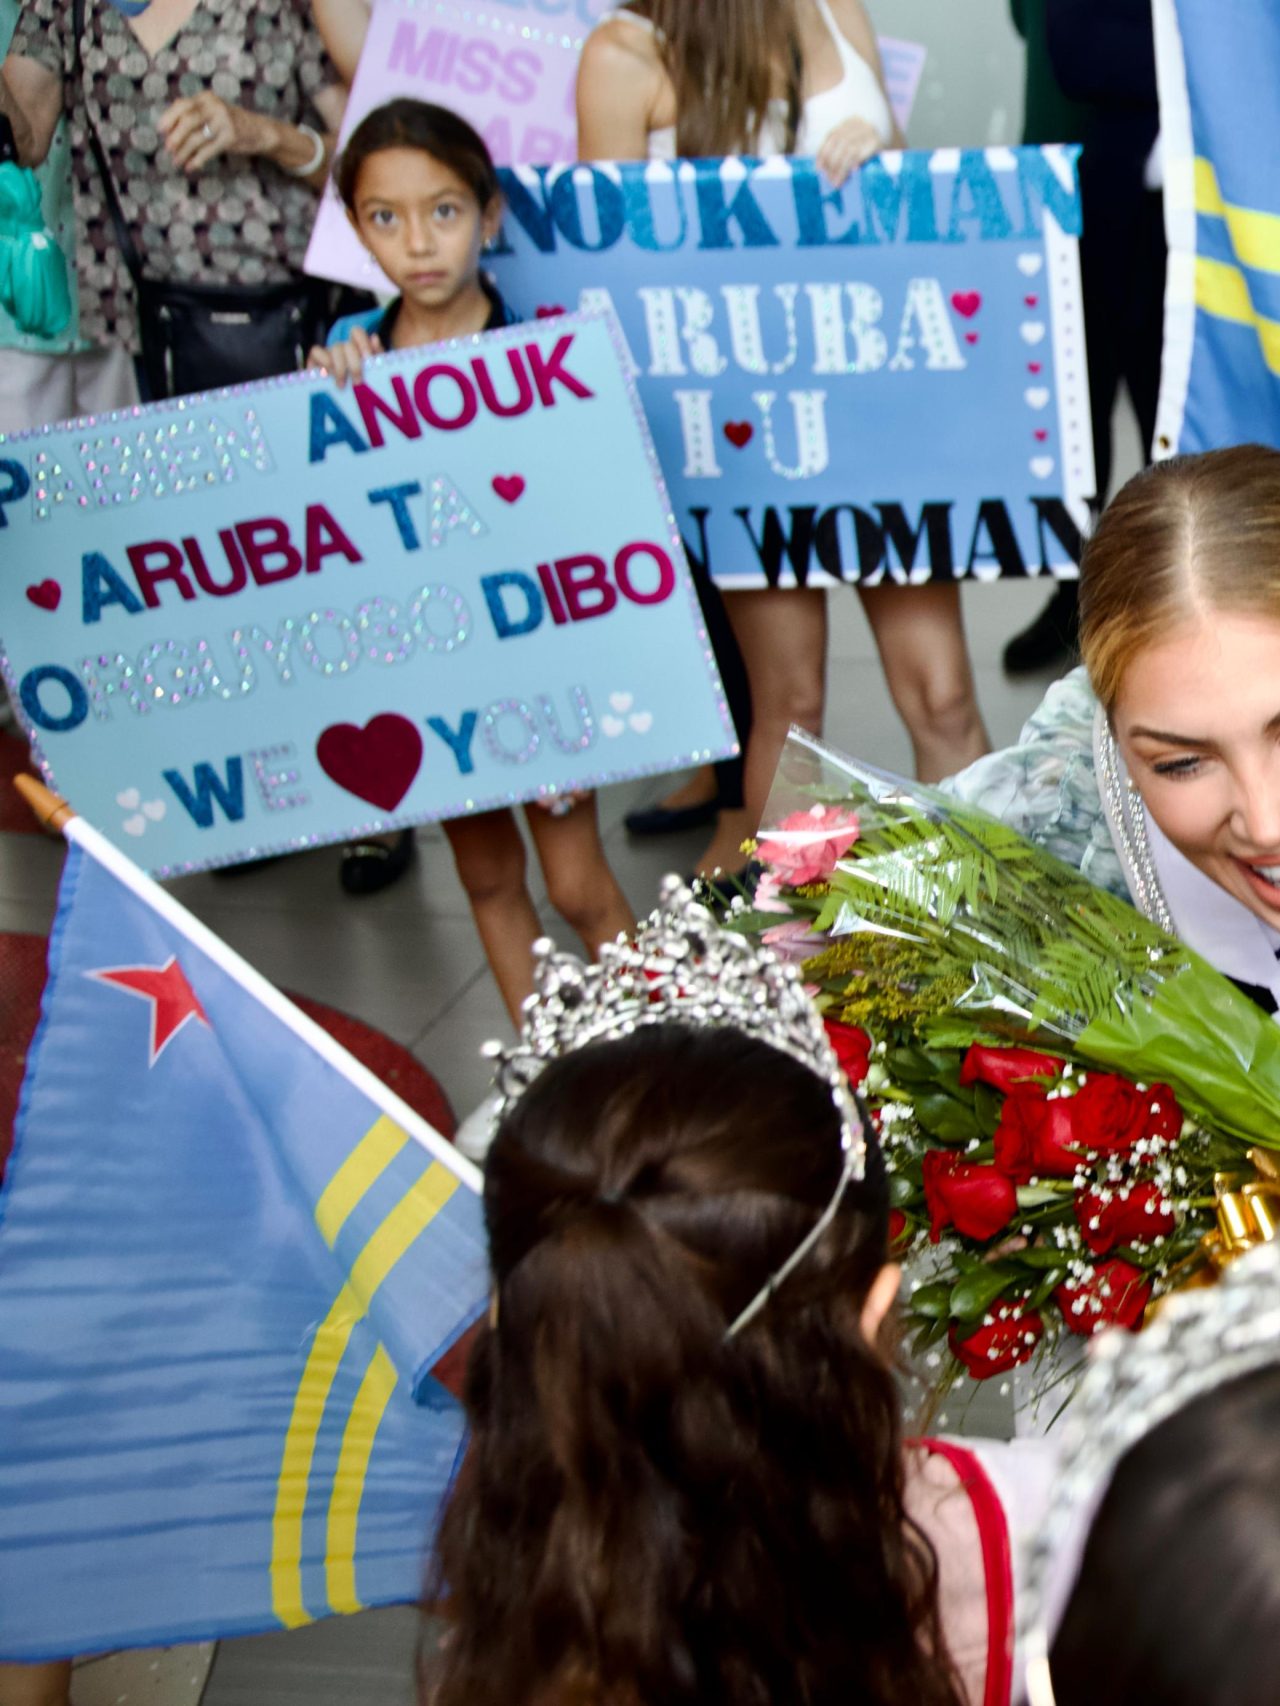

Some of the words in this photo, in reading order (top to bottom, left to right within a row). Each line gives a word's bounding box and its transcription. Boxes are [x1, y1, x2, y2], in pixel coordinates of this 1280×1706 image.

[388, 20, 543, 106] MISS
[308, 334, 594, 463] ANOUK
[674, 390, 722, 478] I
[753, 390, 829, 480] U
[80, 504, 362, 624] ARUBA
[369, 474, 488, 553] TA
[733, 496, 1100, 590] WOMAN
[19, 583, 472, 732] ORGUYOSO
[481, 542, 676, 638] DIBO
[163, 744, 308, 829] WE
[427, 686, 600, 775] YOU
